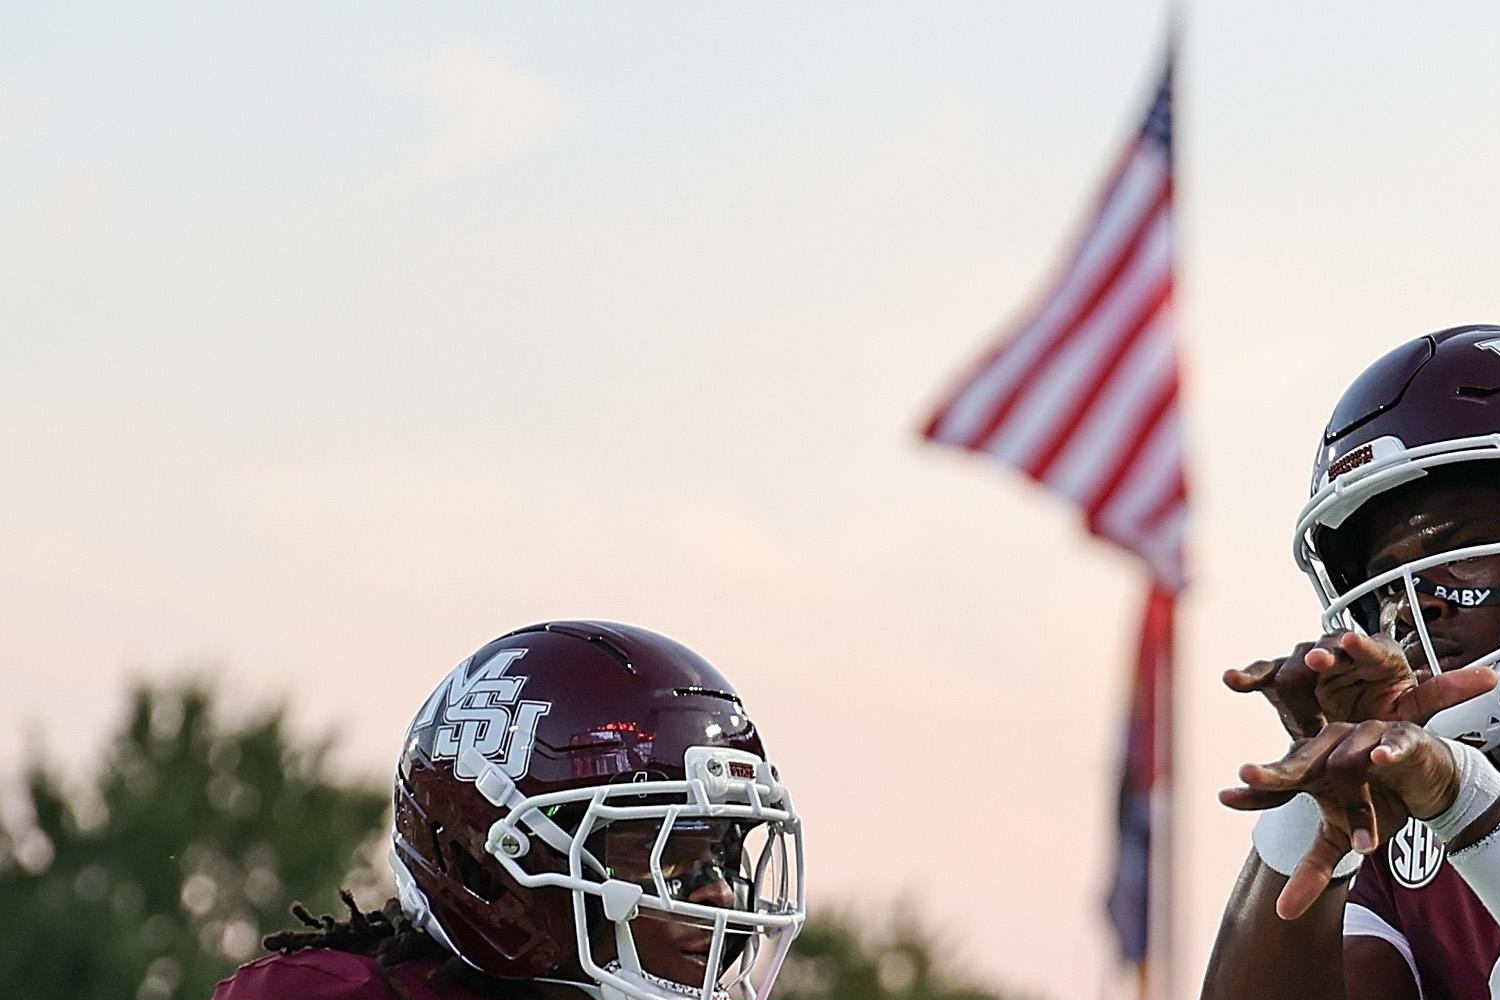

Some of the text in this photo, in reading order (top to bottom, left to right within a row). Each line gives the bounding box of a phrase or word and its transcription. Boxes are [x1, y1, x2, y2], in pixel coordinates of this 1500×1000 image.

[1433, 585, 1491, 606] BABY
[413, 648, 552, 782] MSU
[1393, 817, 1441, 881] SEC
